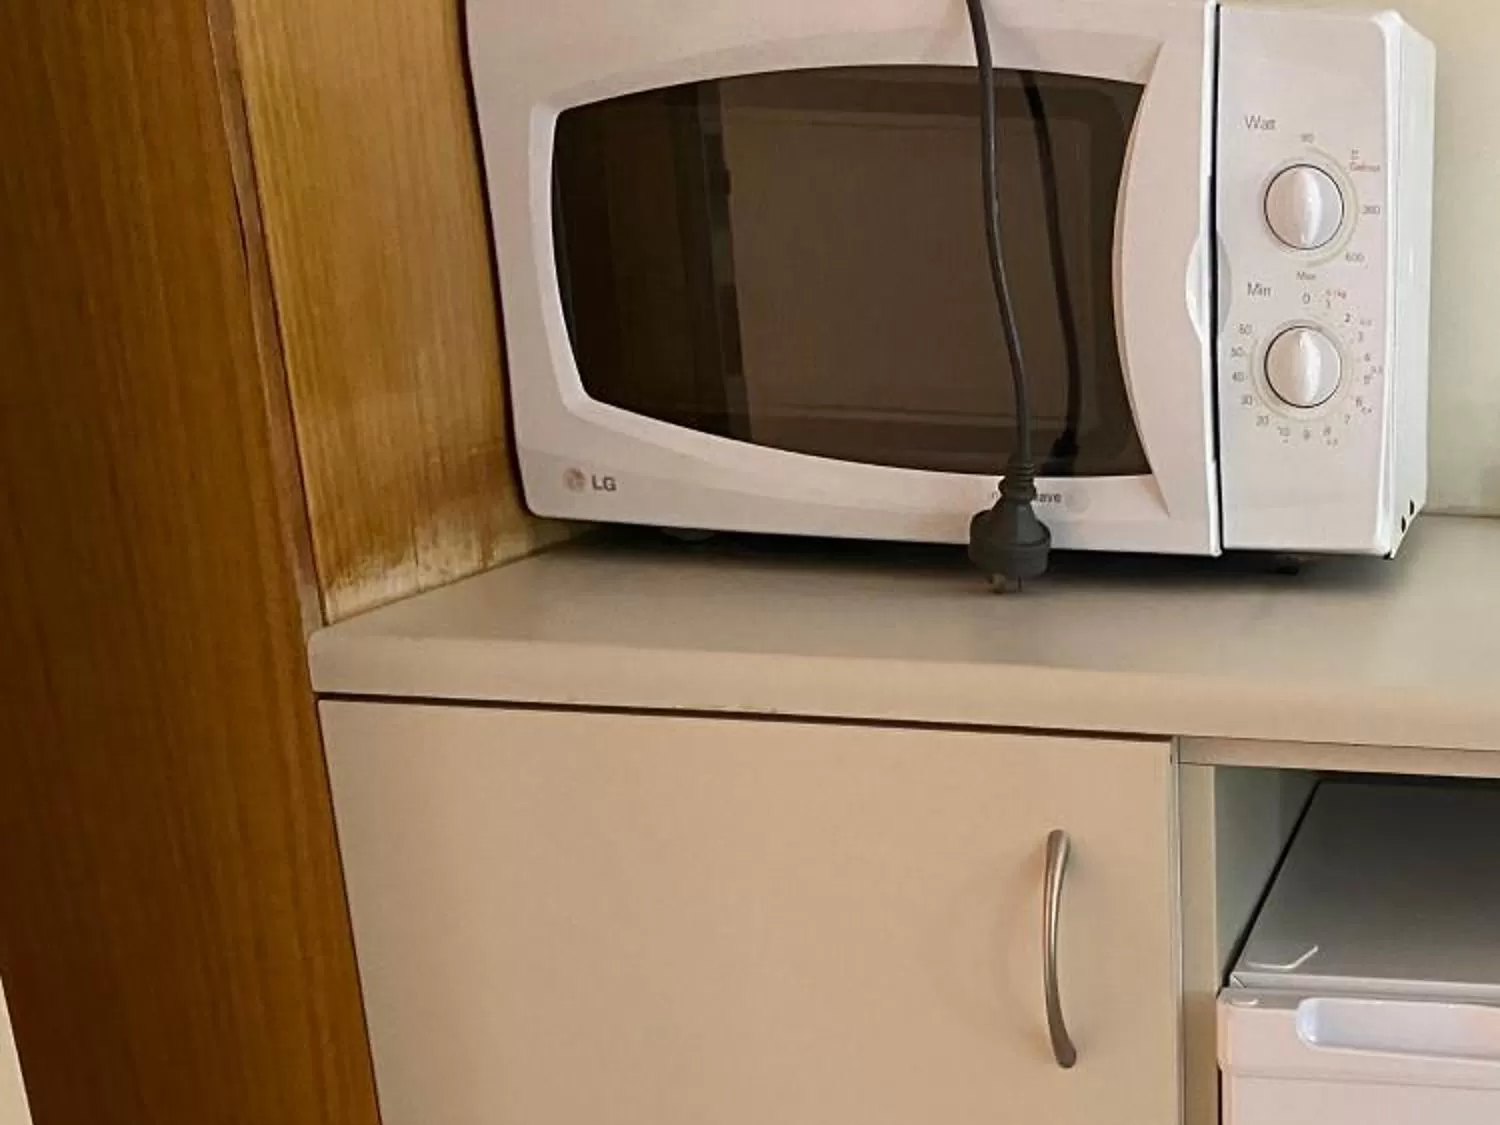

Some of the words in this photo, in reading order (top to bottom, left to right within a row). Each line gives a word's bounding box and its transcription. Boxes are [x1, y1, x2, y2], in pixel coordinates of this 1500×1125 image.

[1244, 115, 1276, 130] Watt
[1247, 281, 1271, 297] Min
[592, 474, 616, 492] LG
